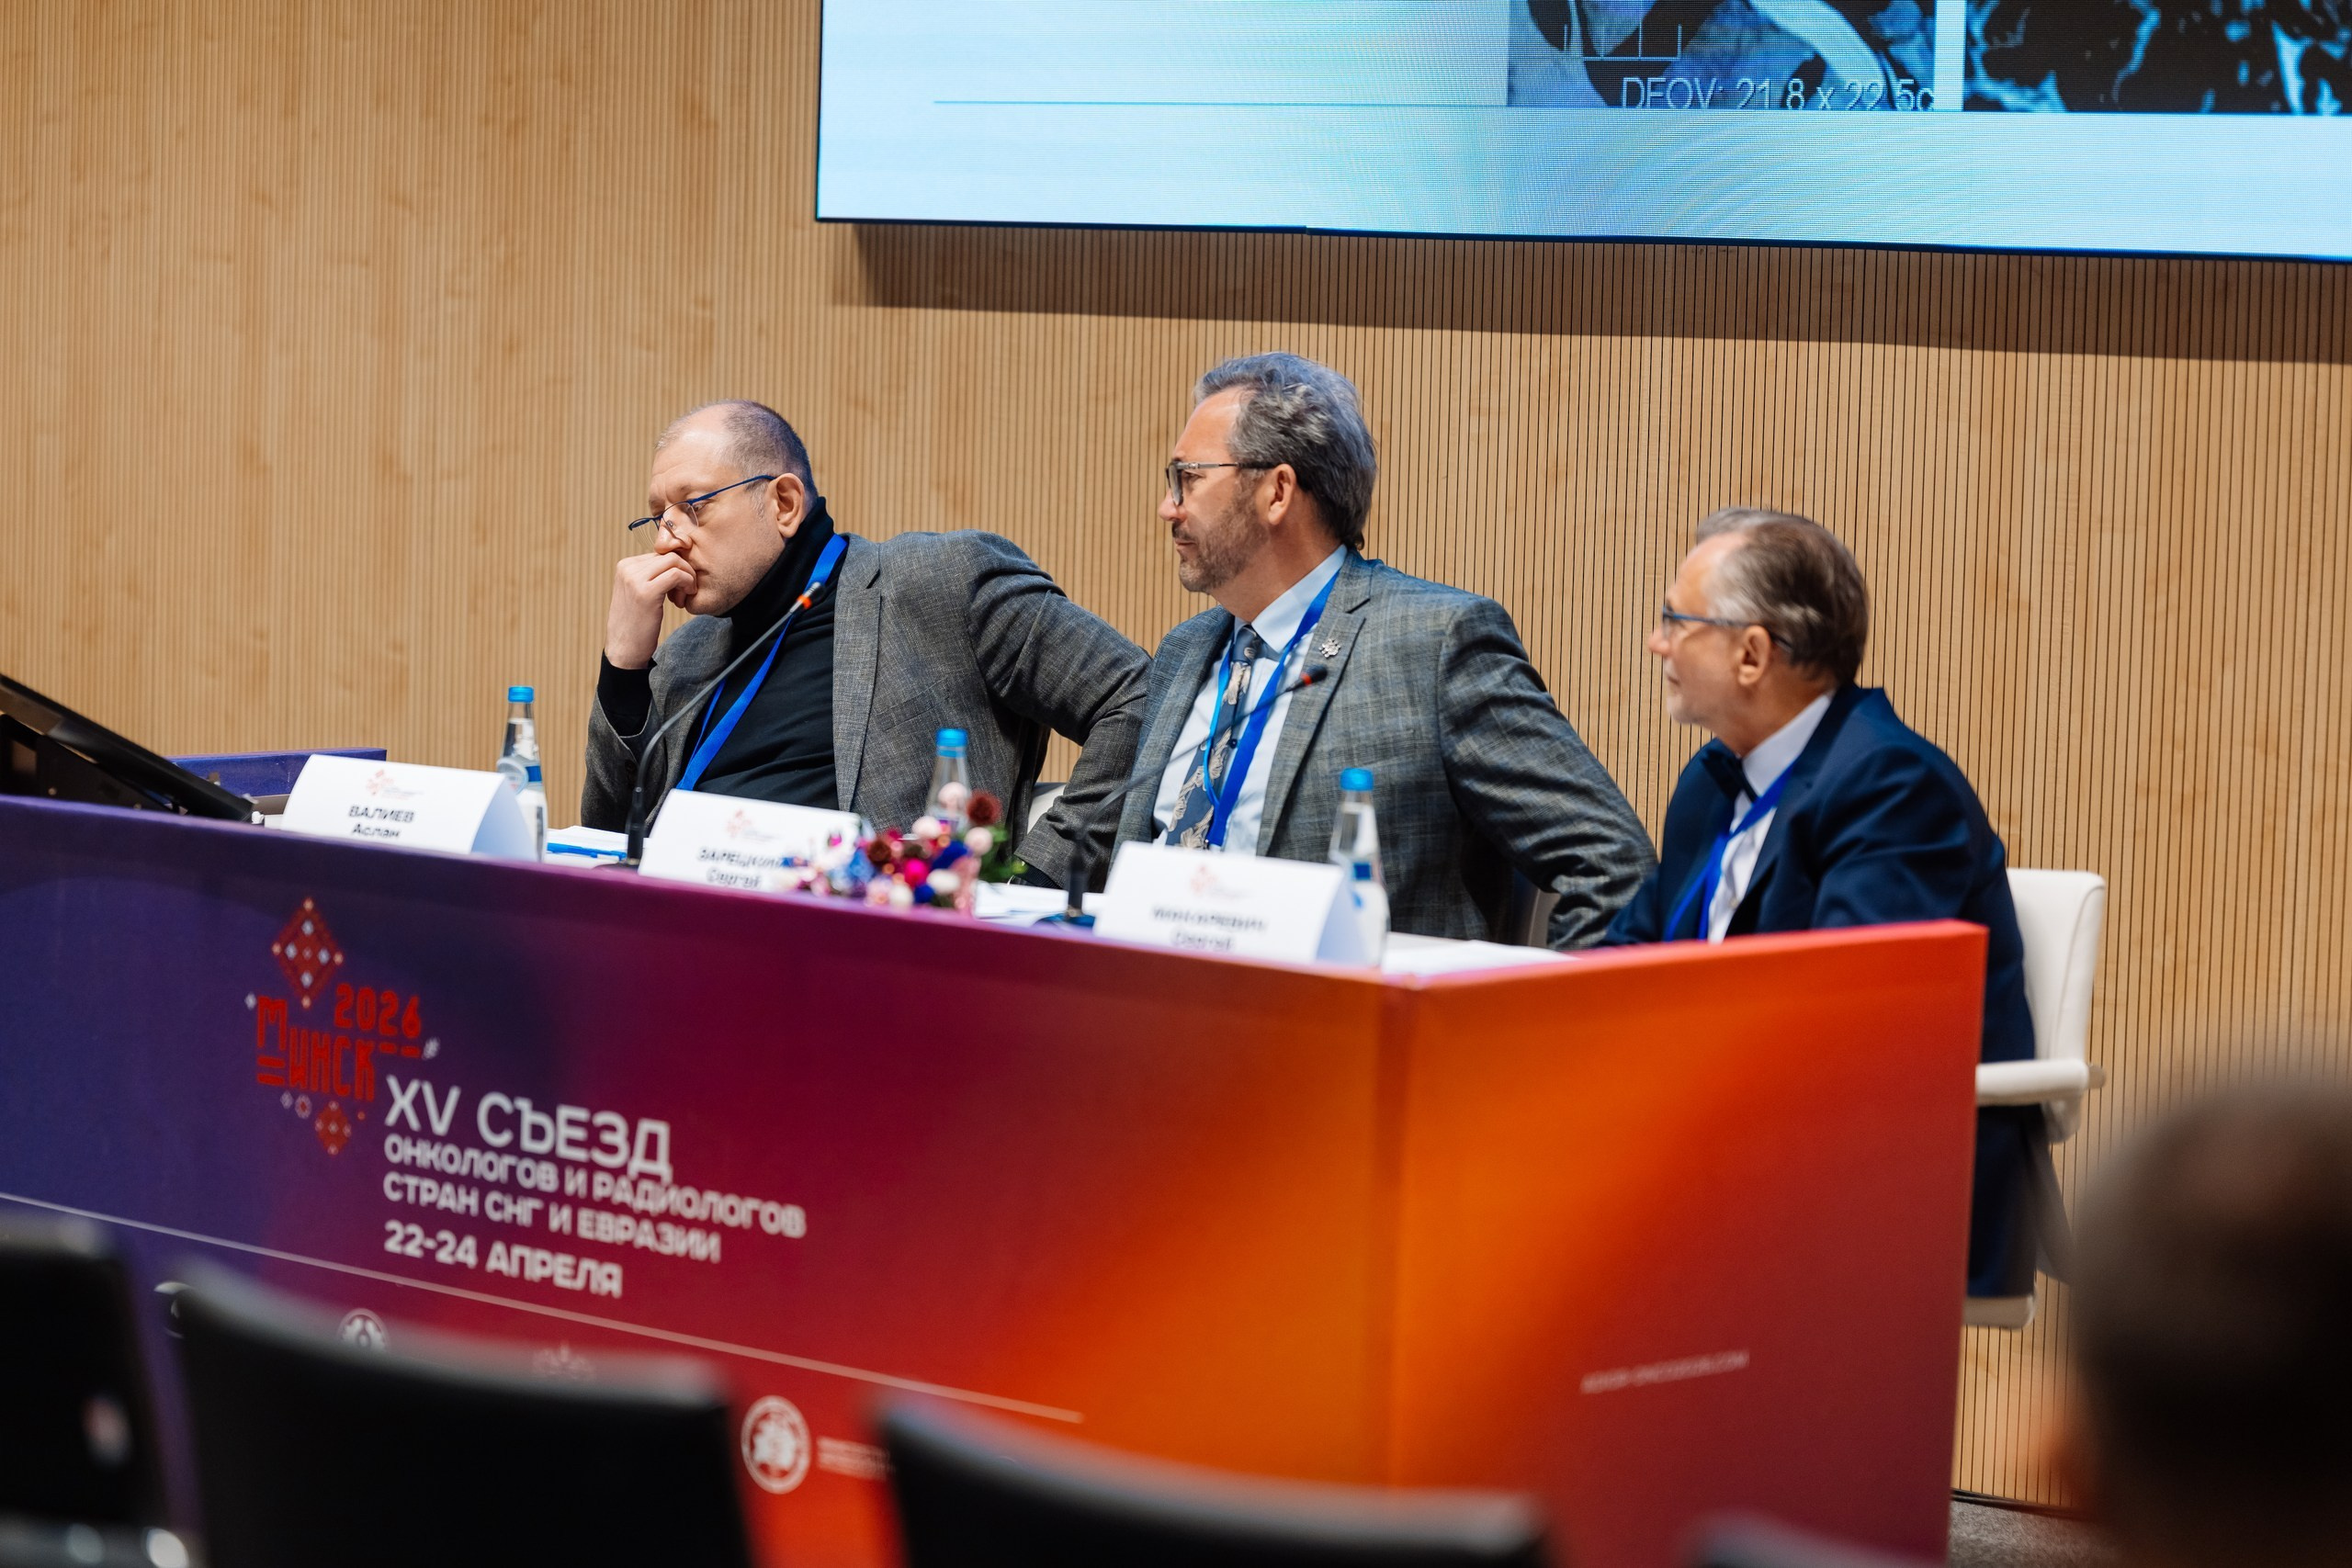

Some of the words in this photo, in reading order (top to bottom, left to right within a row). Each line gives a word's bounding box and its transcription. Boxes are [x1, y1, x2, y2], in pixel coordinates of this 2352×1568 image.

[1736, 78, 1804, 110] 218
[349, 805, 414, 823] ВАЛИЕВ
[353, 823, 401, 838] Аслан
[334, 982, 422, 1040] 2026
[384, 1074, 461, 1137] XV
[476, 1090, 673, 1187] СЪЕЗД
[382, 1170, 481, 1218] СТРАН
[483, 1190, 545, 1228] СНГ
[548, 1201, 572, 1235] И
[576, 1206, 722, 1265] ЕВРАЗИИ
[383, 1133, 560, 1193] ОНКОЛОГОВ
[563, 1165, 588, 1200] И
[592, 1169, 808, 1239] РАДИОЛОГОВ
[383, 1218, 478, 1269] 22-24
[484, 1240, 624, 1299] АПРЕЛЯ
